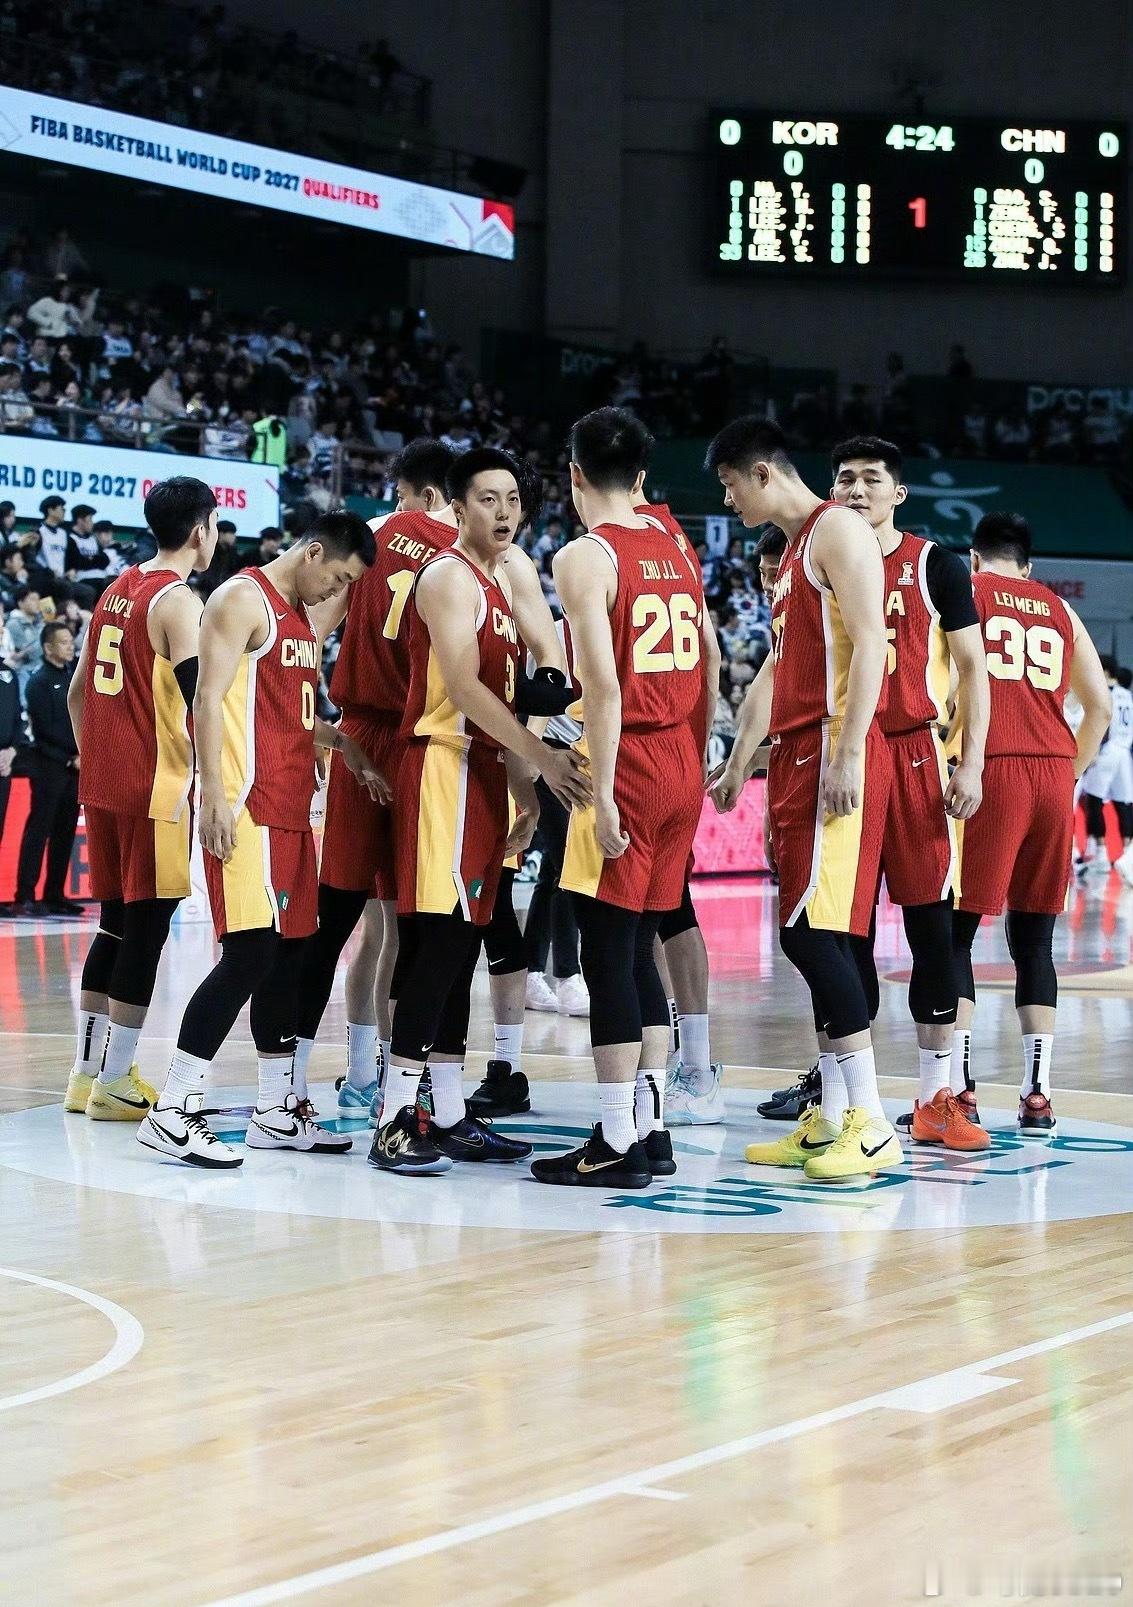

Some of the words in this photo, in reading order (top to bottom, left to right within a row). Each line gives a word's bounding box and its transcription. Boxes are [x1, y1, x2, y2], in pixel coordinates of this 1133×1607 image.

[719, 119, 741, 146] 0
[772, 120, 839, 146] KOR
[885, 123, 955, 152] 4:24
[1001, 128, 1066, 154] CHN
[1098, 131, 1120, 158] 0
[30, 114, 68, 141] FIBA
[73, 126, 173, 164] BASKETBALL
[176, 148, 228, 176] WORLD
[231, 161, 260, 183] CUP
[265, 168, 300, 192] 2027
[302, 178, 381, 210] QUALIFIERS
[783, 150, 804, 177] 0
[1024, 157, 1045, 185] 0
[909, 197, 927, 229] 1
[42, 468, 82, 493] CUP
[89, 473, 137, 498] 2027
[387, 533, 427, 561] ZENG
[638, 560, 662, 580] ZHU
[663, 560, 683, 580] J.L.
[382, 569, 416, 641] 1
[994, 591, 1015, 608] LEI
[1015, 597, 1051, 618] MENG
[632, 593, 701, 674] 26
[93, 624, 124, 696] 5
[281, 638, 317, 670] CHIN
[985, 615, 1065, 693] 39
[301, 680, 315, 731] 0
